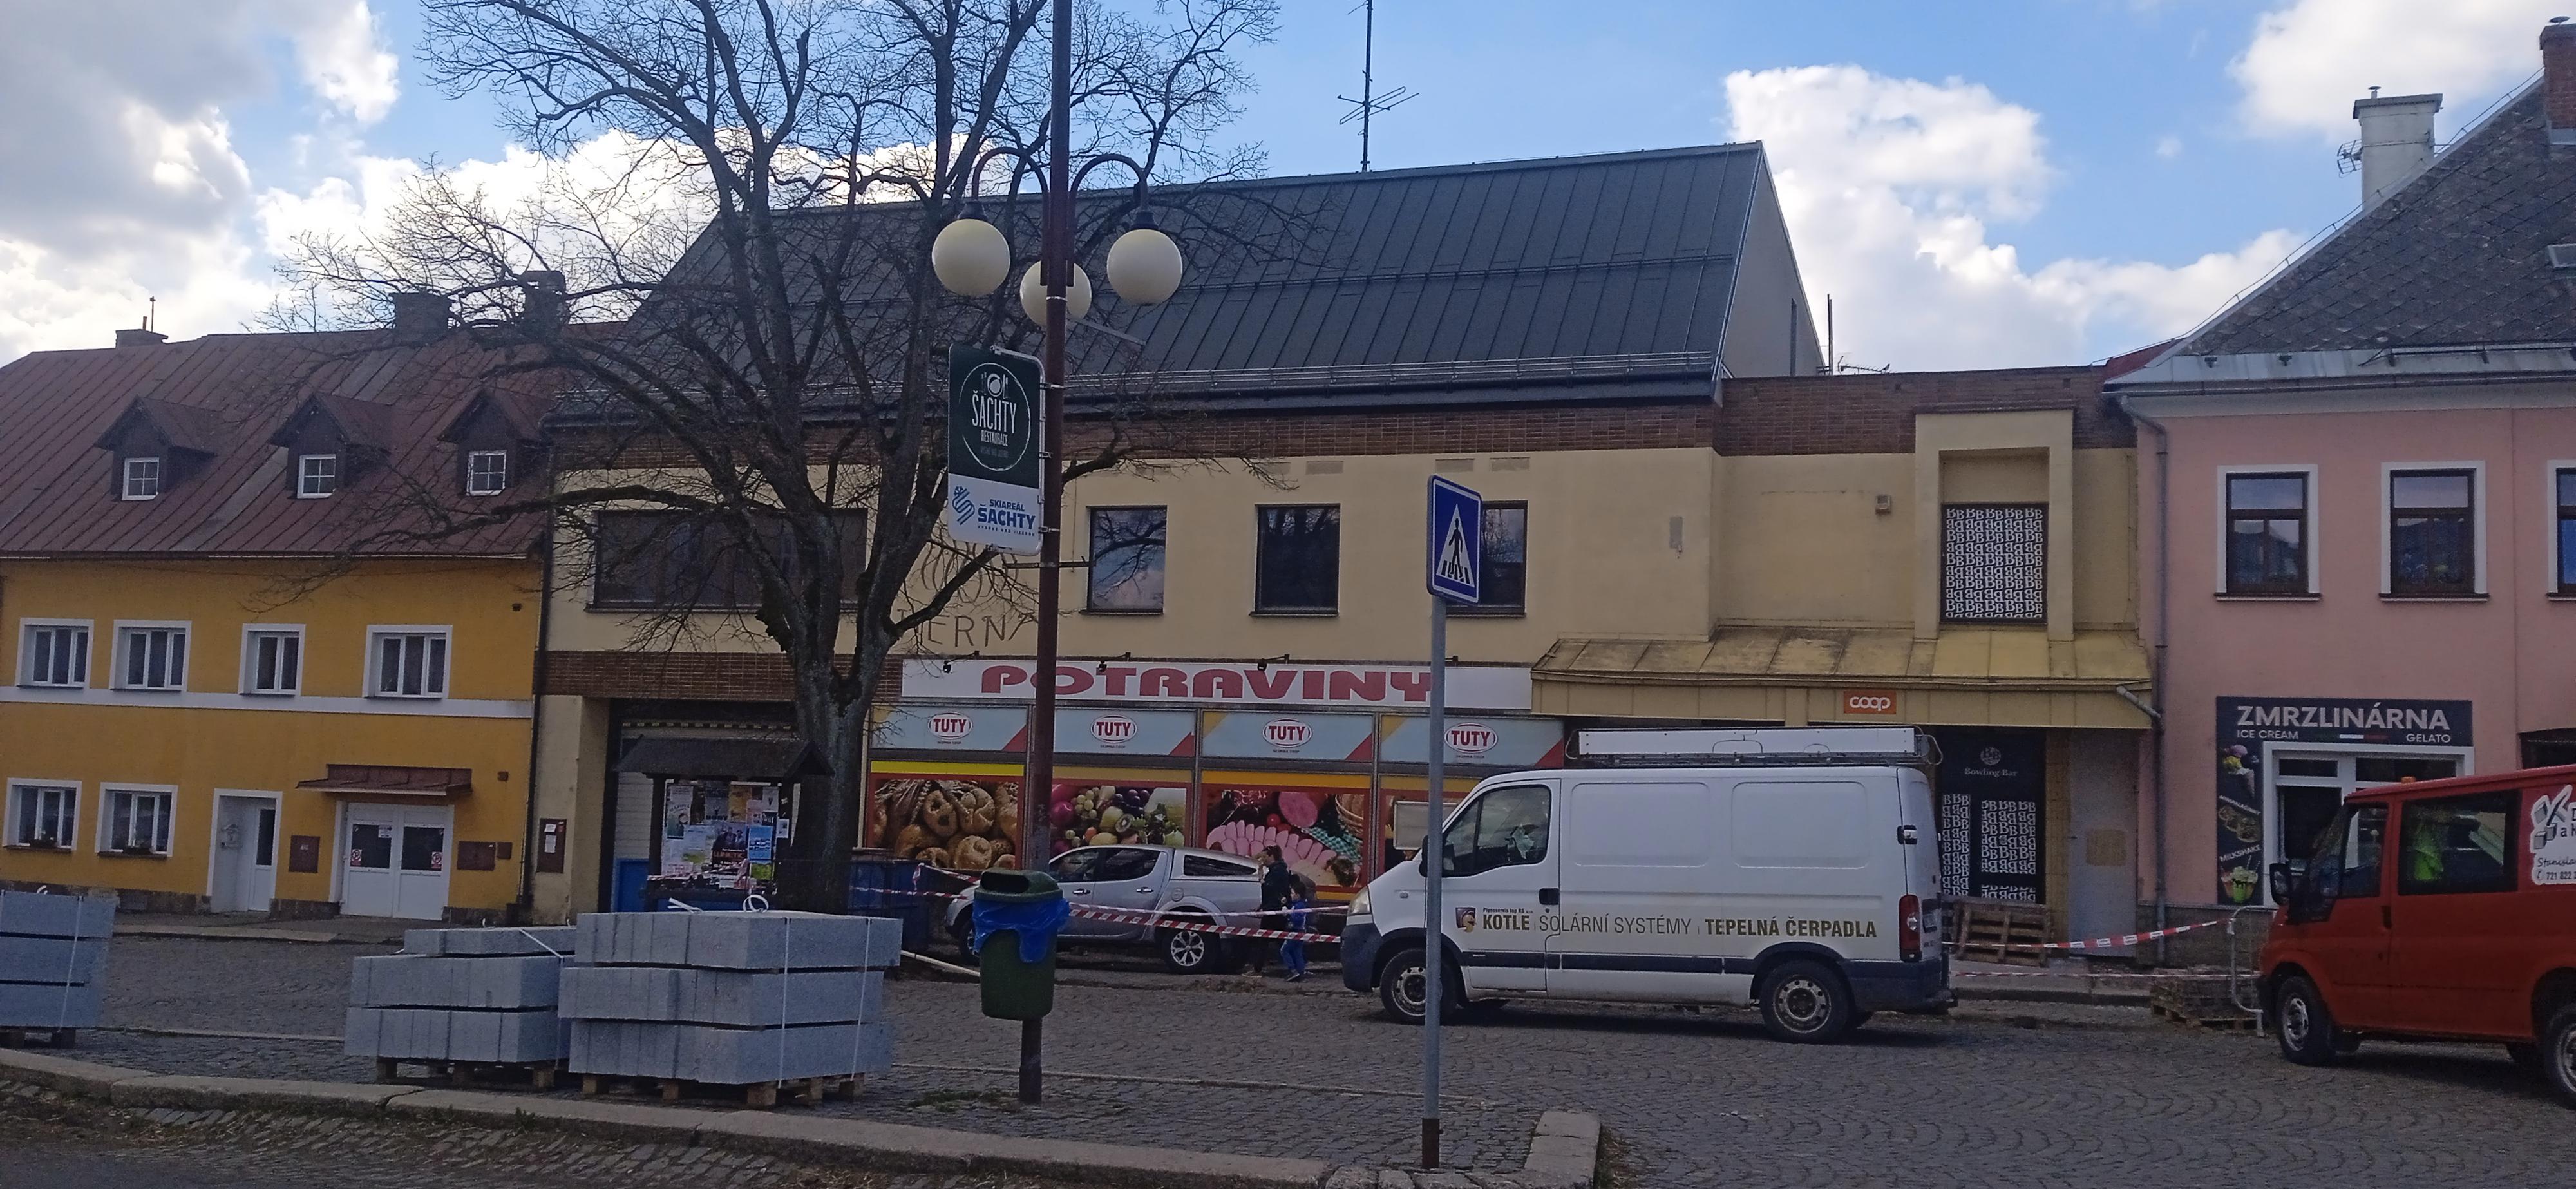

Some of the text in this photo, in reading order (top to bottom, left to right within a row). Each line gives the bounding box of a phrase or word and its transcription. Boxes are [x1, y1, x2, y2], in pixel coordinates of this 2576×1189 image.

[971, 389, 1017, 434] ŠACHTY
[989, 499, 1025, 512] SKIAREÁL
[978, 503, 1036, 530] ŠACHTY
[981, 665, 1432, 703] POTRAVINY
[1849, 696, 1891, 712] coop
[2237, 702, 2450, 730] ZMRZLINÁRNA
[933, 718, 967, 733] TUTY
[1096, 721, 1132, 737] TUTY
[1268, 725, 1306, 741] TUTY
[1451, 730, 1491, 747] TUTY
[2237, 729, 2299, 740] ICE CREAM
[2406, 733, 2451, 743] GELATO
[2220, 844, 2262, 862] MILKSHAKE
[1483, 912, 1877, 938] KOTLE SOLÁRNÍ SYSTÉMY TEPELNÁ ČERPADLA
